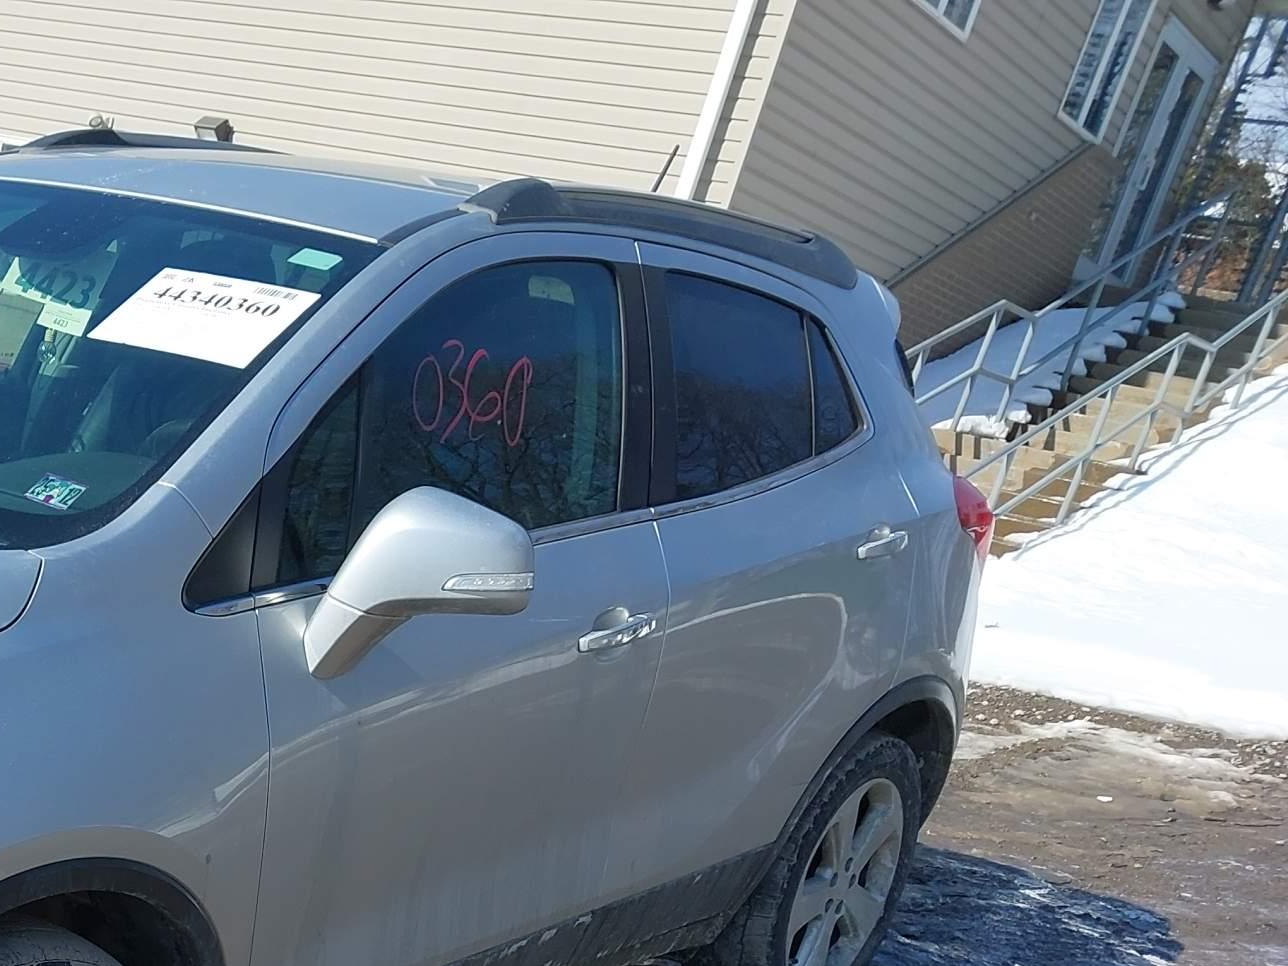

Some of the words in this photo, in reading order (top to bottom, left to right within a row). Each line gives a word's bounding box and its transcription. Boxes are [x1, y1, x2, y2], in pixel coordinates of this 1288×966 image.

[15, 261, 96, 309] 4423
[153, 285, 281, 317] 44340360
[412, 339, 532, 446] 0360
